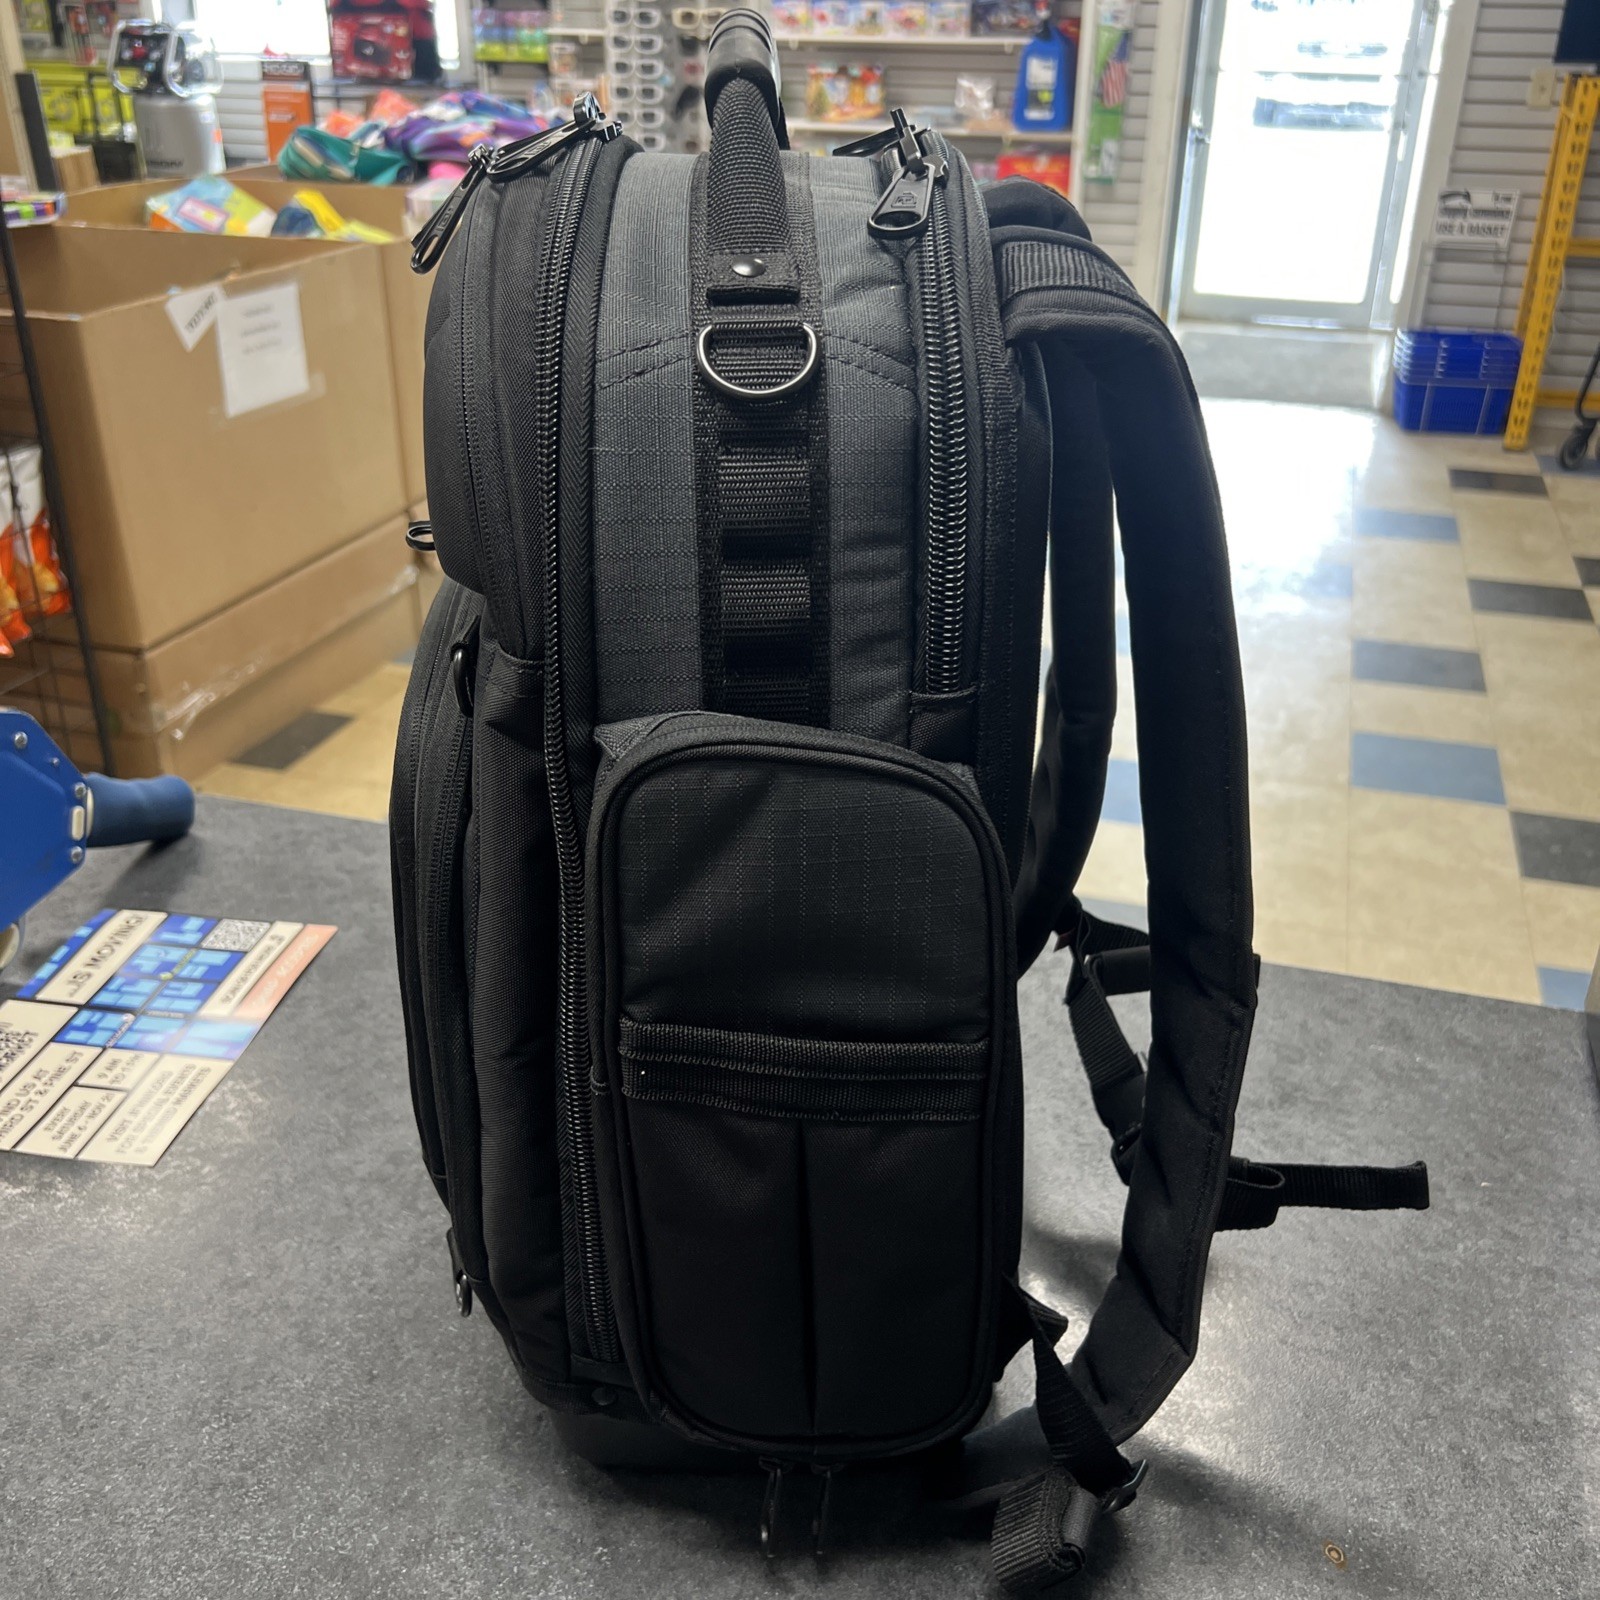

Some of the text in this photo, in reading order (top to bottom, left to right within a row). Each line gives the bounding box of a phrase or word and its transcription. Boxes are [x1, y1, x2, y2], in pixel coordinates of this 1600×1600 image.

[21, 1099, 39, 1112] ST
[43, 1065, 70, 1087] PINE
[65, 1050, 84, 1063] ST
[97, 1058, 122, 1080] 9 AM
[172, 1066, 212, 1107] MARKETS
[0, 1069, 50, 1120] IND US AT
[116, 1136, 137, 1154] FOR
[164, 1063, 196, 1097] EVENTS
[44, 1107, 71, 1133] EVERY
[51, 1100, 92, 1141] SATURDAY
[58, 1133, 78, 1153] JUNE
[89, 1103, 106, 1119] NOV
[107, 1118, 133, 1143] VISIT
